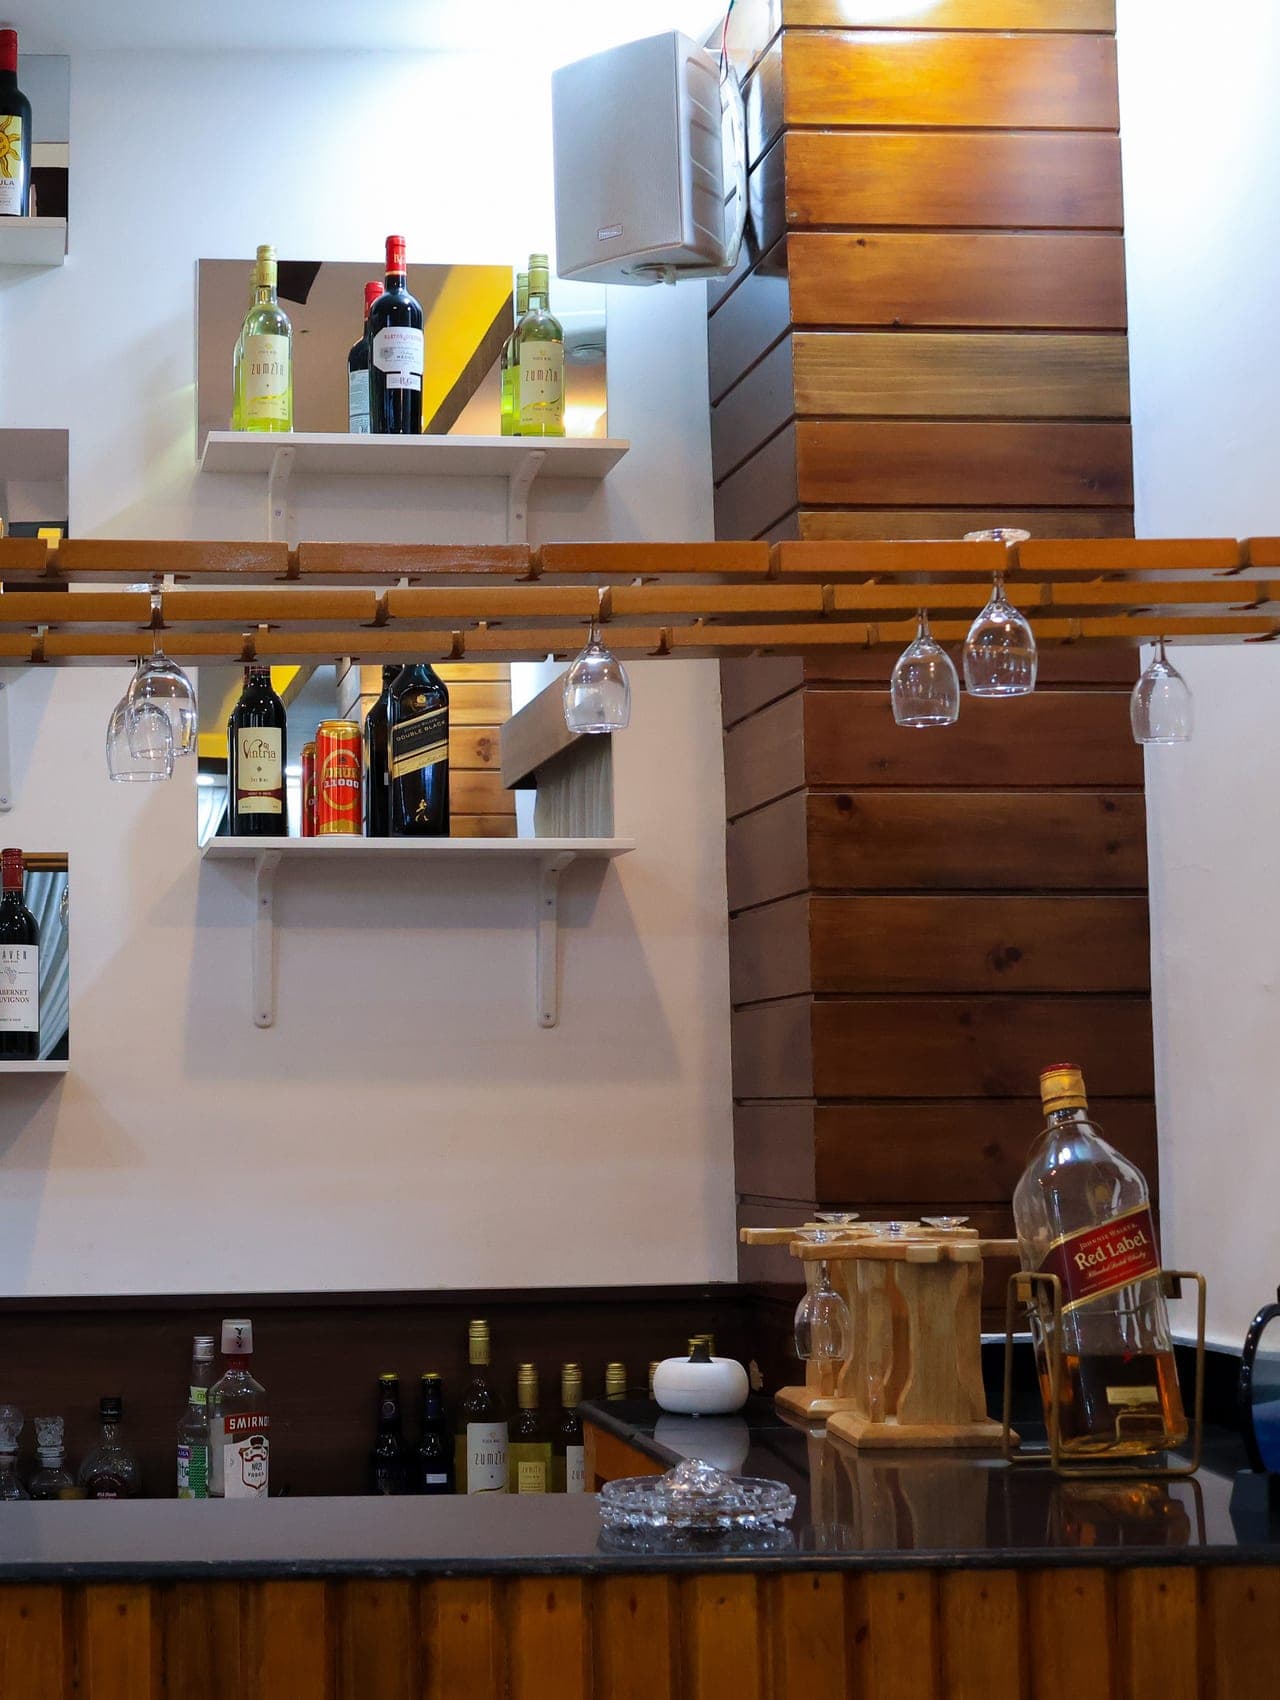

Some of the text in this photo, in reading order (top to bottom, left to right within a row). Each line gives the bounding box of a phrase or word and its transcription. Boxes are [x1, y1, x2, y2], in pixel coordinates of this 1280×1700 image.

[395, 719, 446, 742] DOUBLE BLACK
[324, 766, 359, 778] DRUK
[323, 778, 360, 789] 11000
[1073, 1230, 1148, 1271] Red Label
[1079, 1234, 1108, 1251] JOHNNIE
[229, 1415, 270, 1430] SMIRNO
